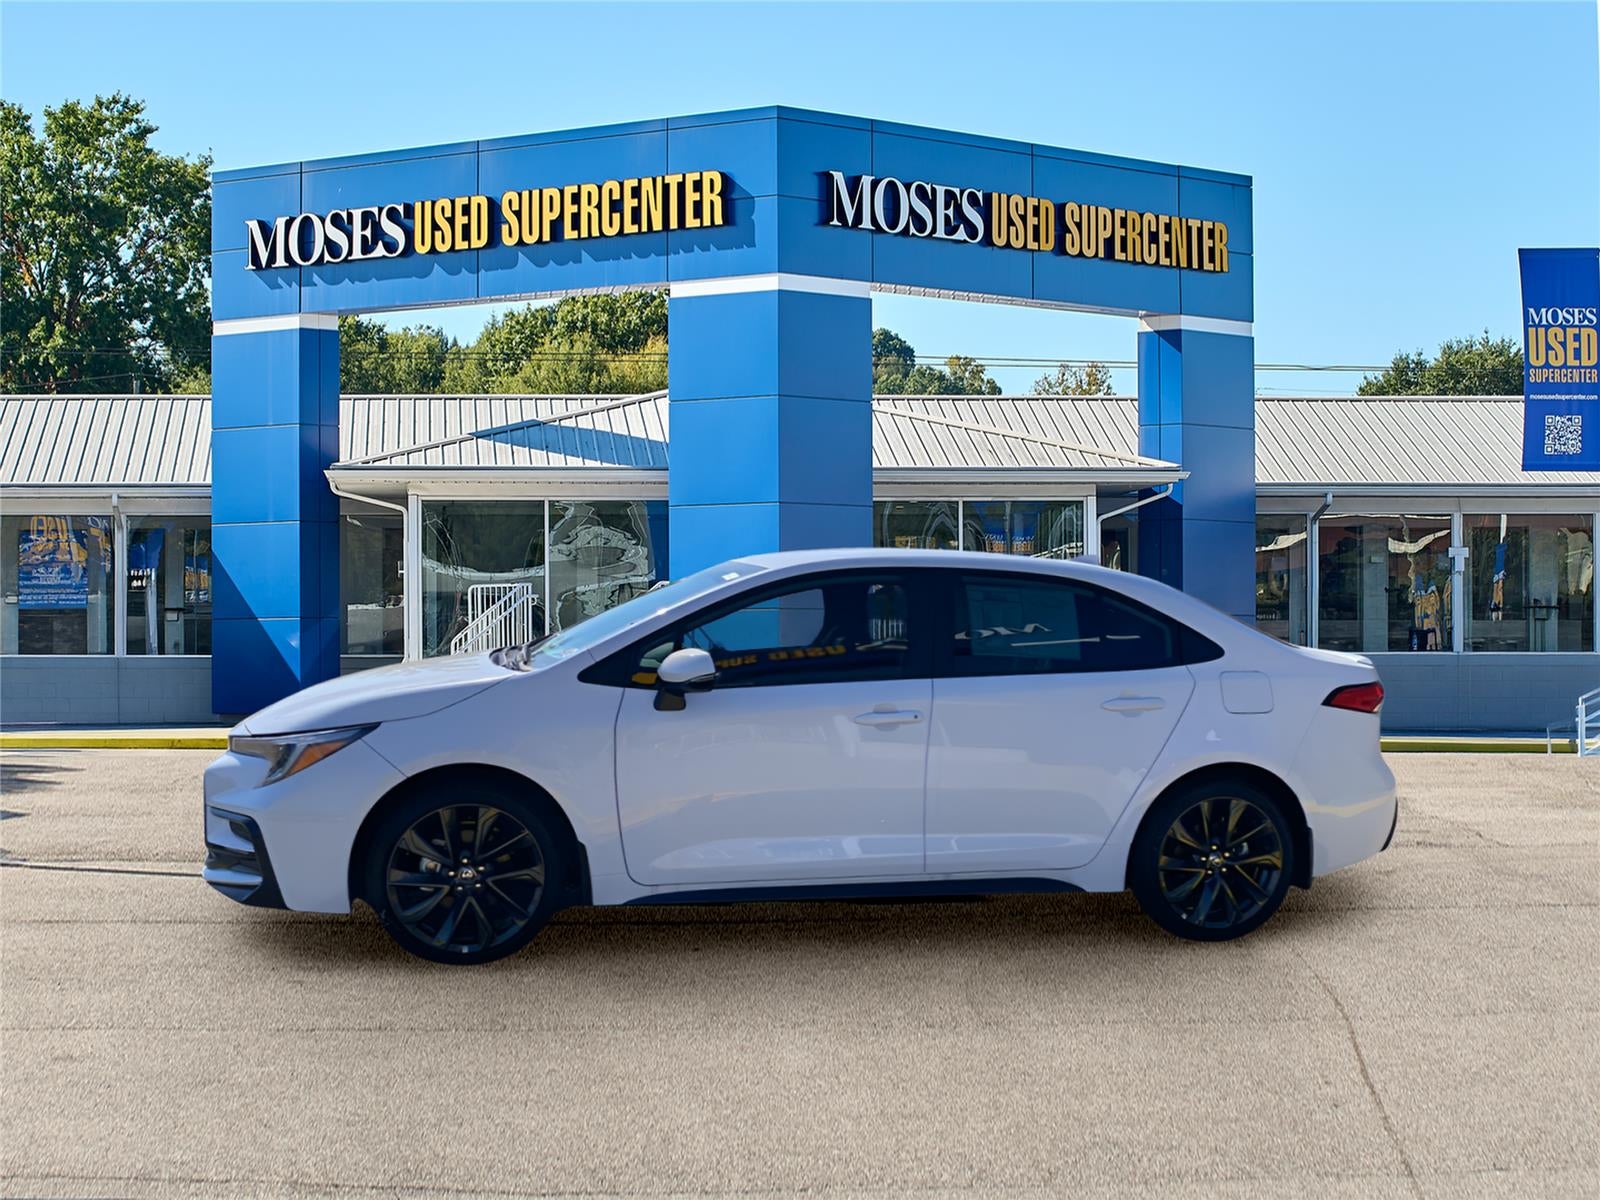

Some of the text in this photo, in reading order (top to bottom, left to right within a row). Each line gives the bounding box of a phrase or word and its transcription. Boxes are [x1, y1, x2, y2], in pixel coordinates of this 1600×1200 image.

[244, 170, 725, 271] MOSES USED SUPERCENTER
[829, 170, 1230, 273] MOSES USED SUPERCENTER
[1527, 307, 1598, 326] MOSES
[1528, 327, 1598, 366] USED
[1529, 368, 1598, 383] SUPERCENTER
[1529, 393, 1598, 401] mosesusedsupercenter.com
